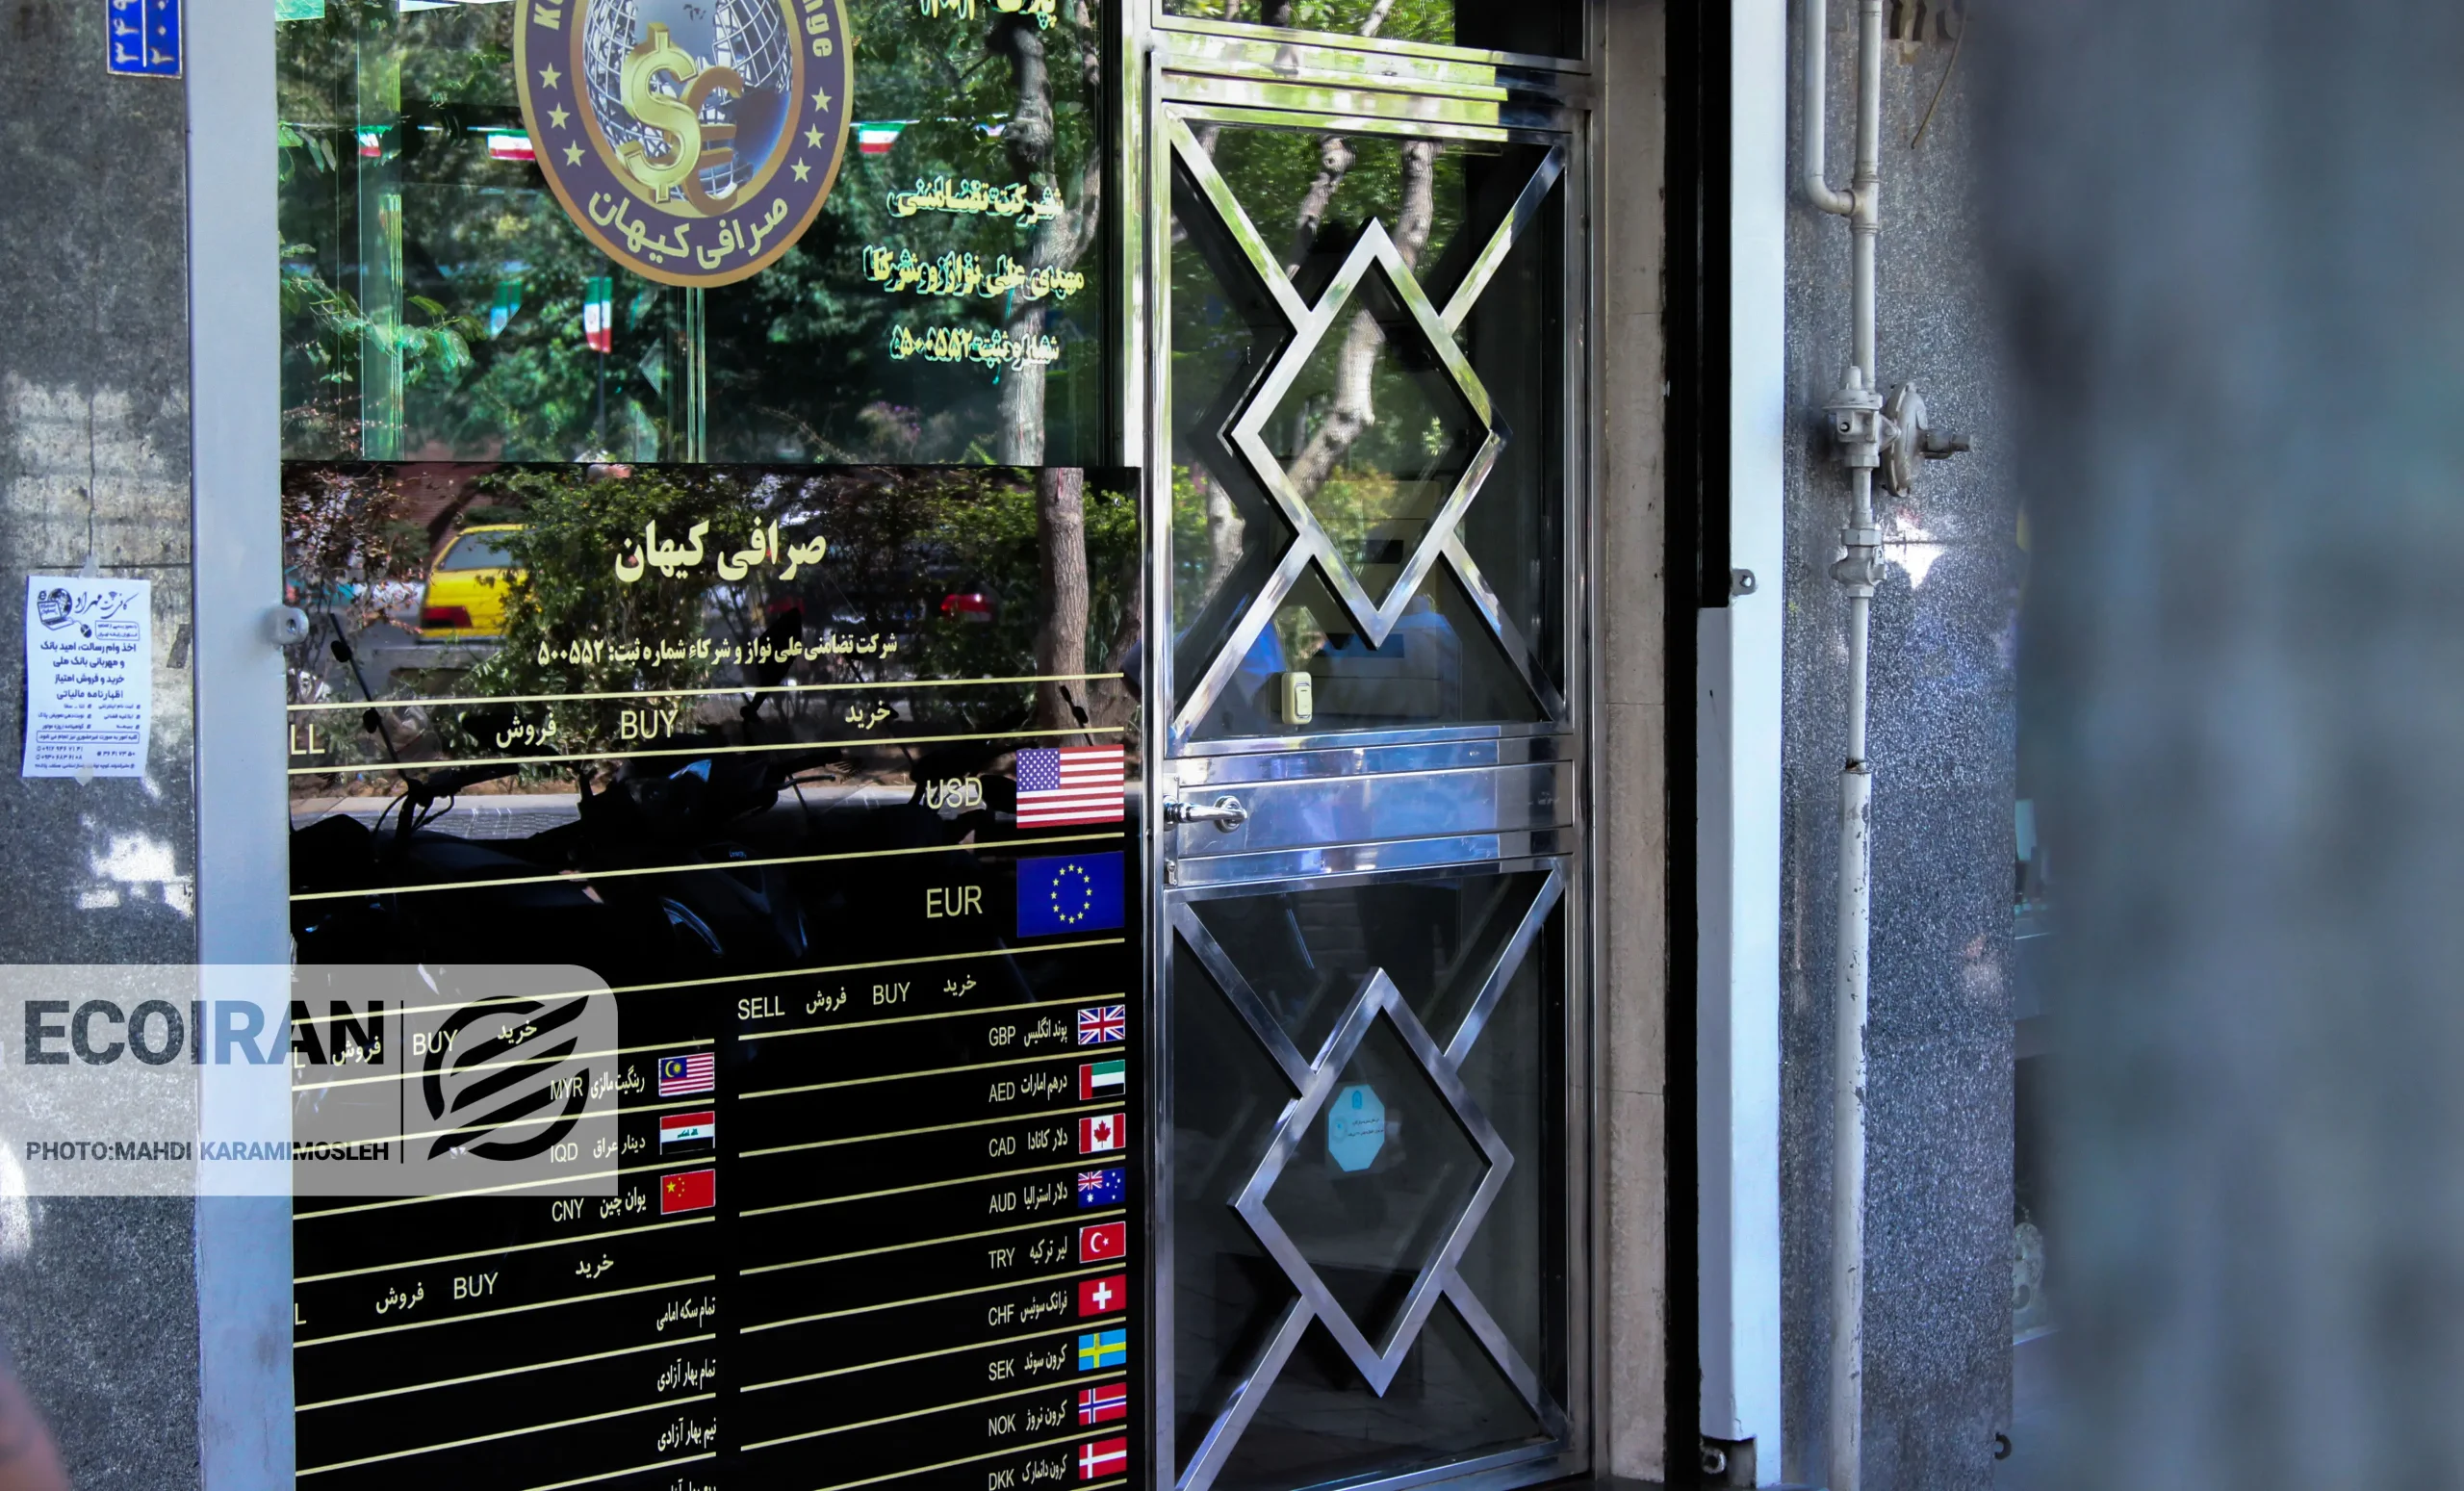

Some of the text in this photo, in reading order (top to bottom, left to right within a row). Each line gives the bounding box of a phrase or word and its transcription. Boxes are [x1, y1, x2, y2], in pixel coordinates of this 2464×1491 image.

[587, 191, 789, 270] صرافی کیهان
[986, 256, 1026, 296] علی
[614, 515, 827, 582] صرافی کیهان
[40, 641, 59, 651] بانک
[59, 642, 76, 651] امید
[105, 643, 120, 655] وام
[121, 643, 137, 653] اخذ
[537, 638, 604, 666] ۵۰۰۵۵۲
[607, 637, 641, 666] ثبت:
[642, 638, 686, 667] شماره
[732, 644, 743, 665] و
[744, 635, 772, 664] نواز
[774, 635, 803, 664] علی
[804, 633, 854, 662] تضامنی
[856, 631, 898, 659] شرکت
[53, 656, 69, 668] ملی
[70, 656, 89, 666] بانک
[90, 657, 118, 669] مهربانی
[54, 674, 75, 684] امتیاز
[76, 674, 99, 684] فروش
[106, 674, 125, 684] خرید
[56, 690, 124, 701] اظهارنامه مالیاتی
[621, 708, 679, 740] BUY
[844, 700, 890, 730] خرید
[496, 712, 557, 748] فروش
[926, 777, 983, 810] USD
[926, 885, 983, 918] EUR
[872, 981, 911, 1006] BUY
[942, 974, 977, 997] خرید
[737, 995, 785, 1020] SELL
[806, 987, 848, 1015] فروش
[413, 1029, 459, 1056] BUY
[497, 1020, 538, 1044] خرید
[988, 1016, 1068, 1047] پوند انگلیس GBP
[332, 1035, 382, 1067] فروش
[550, 1065, 646, 1100] رینگیت مالزی MYR
[988, 1071, 1067, 1103] درهم امارات AED
[551, 1134, 646, 1163] دینار عراق IQD
[988, 1127, 1068, 1158] دلار کانادا CAD
[552, 1186, 647, 1222] یوان چین CNY
[988, 1181, 1068, 1214] دلار استرالیا AUD
[575, 1253, 614, 1279] خرید
[988, 1235, 1067, 1269] لیر ترکیه TRY
[375, 1282, 424, 1314] فروش
[453, 1272, 499, 1299] BUY
[656, 1296, 716, 1331] تمام سکه امامی
[988, 1290, 1068, 1326] فرانک سوئیس CHF
[656, 1357, 716, 1392] تمام بهار آزادی
[988, 1343, 1067, 1381] کرون سوئد SEK
[988, 1400, 1067, 1437] کرون نروژ NOK
[657, 1416, 717, 1452] نیم بهار آزادی
[988, 1453, 1067, 1491] کرون دانمارک DKK
